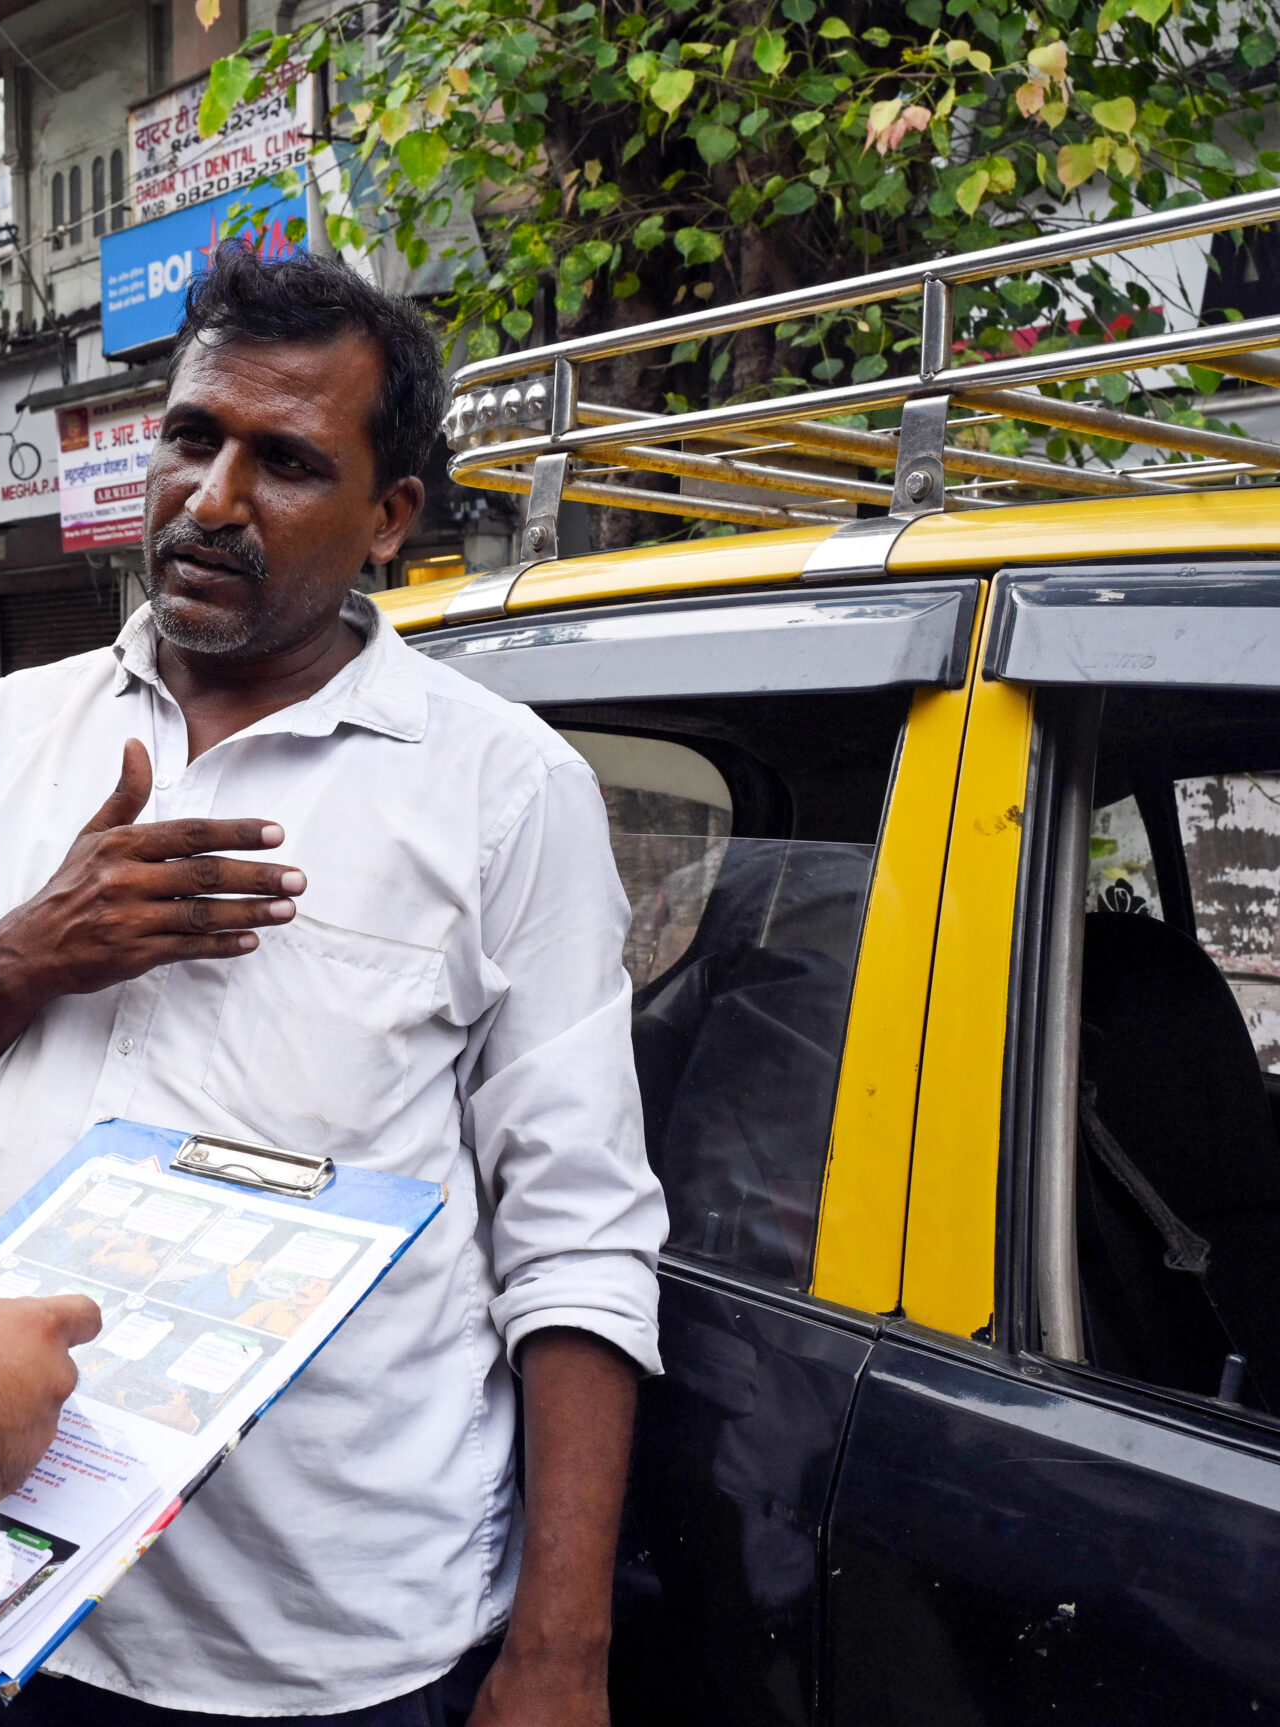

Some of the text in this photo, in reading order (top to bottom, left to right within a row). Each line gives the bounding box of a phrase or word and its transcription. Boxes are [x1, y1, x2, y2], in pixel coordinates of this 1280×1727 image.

[136, 174, 176, 204] DADAR
[176, 147, 306, 208] 9820322536
[148, 250, 192, 299] BOI
